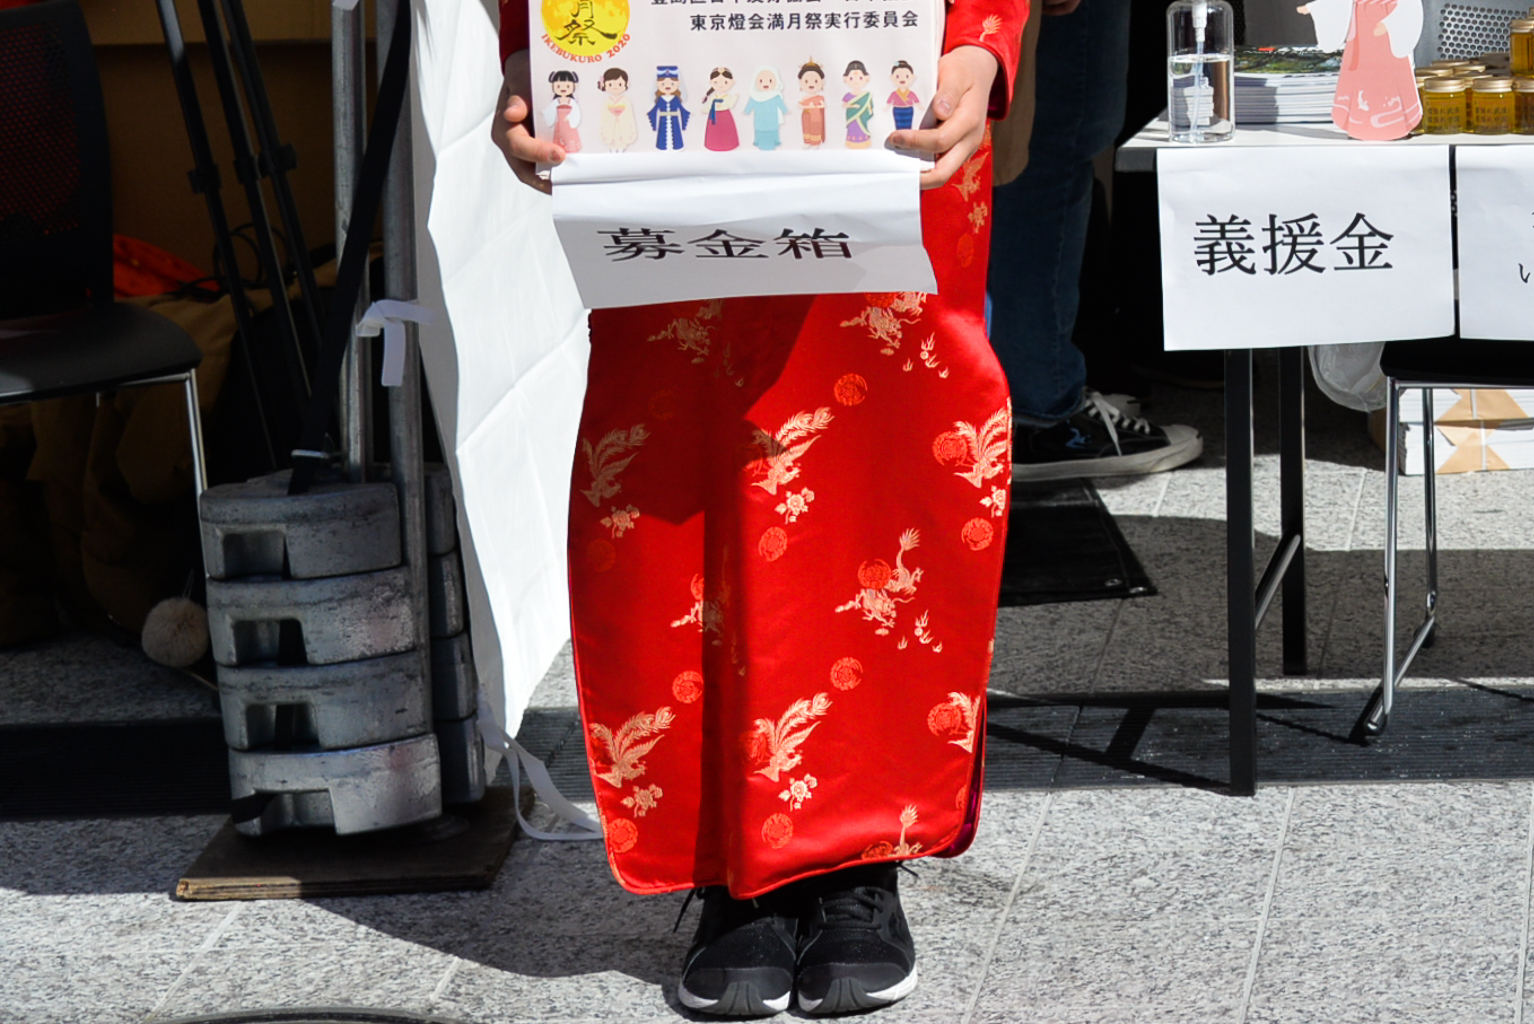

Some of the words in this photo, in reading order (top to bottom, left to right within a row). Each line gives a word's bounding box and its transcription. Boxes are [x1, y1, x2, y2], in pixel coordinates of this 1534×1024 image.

[690, 10, 919, 31] 東京燈会満月祭実行委員会
[540, 33, 603, 64] IKEBUKURO
[606, 32, 632, 59] 2020
[596, 226, 853, 263] 募金箱
[1192, 211, 1395, 276] 義援金
